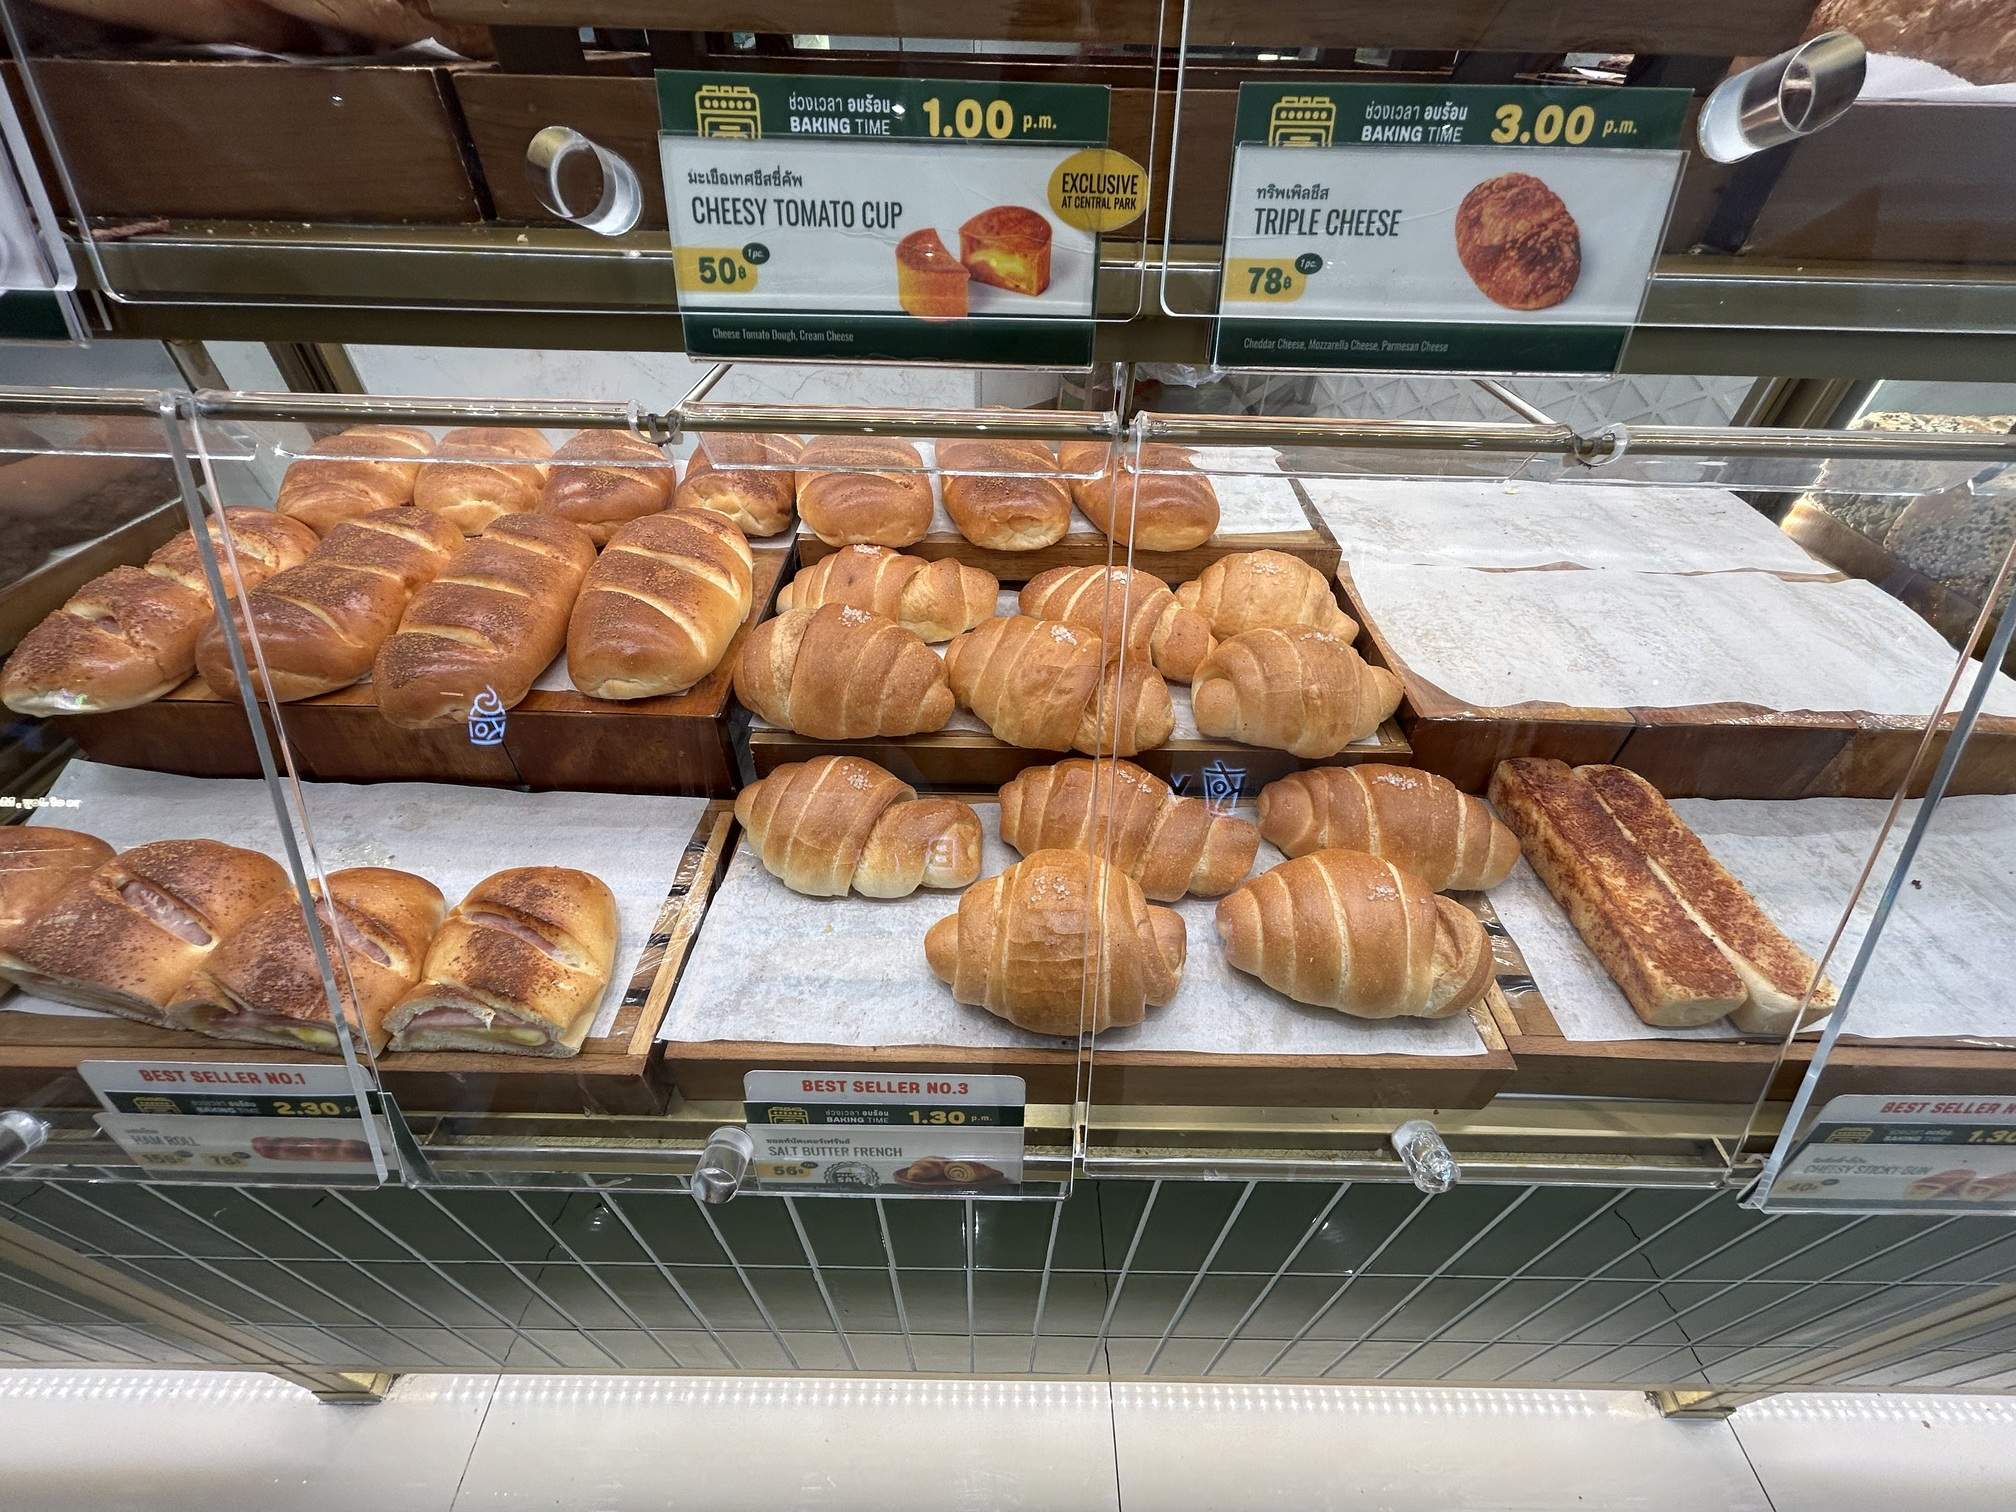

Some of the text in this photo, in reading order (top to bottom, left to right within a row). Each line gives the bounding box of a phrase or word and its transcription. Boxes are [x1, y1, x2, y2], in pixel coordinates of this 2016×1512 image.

[789, 91, 890, 114] ช่วงเวลา อบร้อน
[1365, 100, 1468, 121] ช่วงเวลา อบร้อน
[790, 117, 890, 136] BAKING TIME
[922, 97, 1057, 139] 1.00 p.m.
[1490, 103, 1638, 145] 3.00 p.m.
[1361, 125, 1464, 143] BAKING TIME
[1062, 173, 1139, 195] EXCLUSIVE
[1061, 195, 1136, 210] AT CENTRAL PARK
[692, 197, 902, 229] CHEESY TOMATO CUP
[1255, 208, 1402, 237] TRIPLE CHEESE
[712, 327, 854, 342] Cheese Tomato Dough, Cream Cheese
[1244, 337, 1449, 352] Cheddar Cheese, Mozzarella Cheese, Parmesan Cheese
[138, 1069, 306, 1085] BEST SELLER NO.1
[802, 1079, 969, 1095] BEST SELLER NO.3
[272, 1101, 341, 1115] 2.30
[1880, 1102, 1931, 1113] BEST
[1931, 1103, 2000, 1114] SELLER
[908, 1110, 966, 1125] 1.30
[768, 1146, 903, 1158] SALT BUTTER FRENCH
